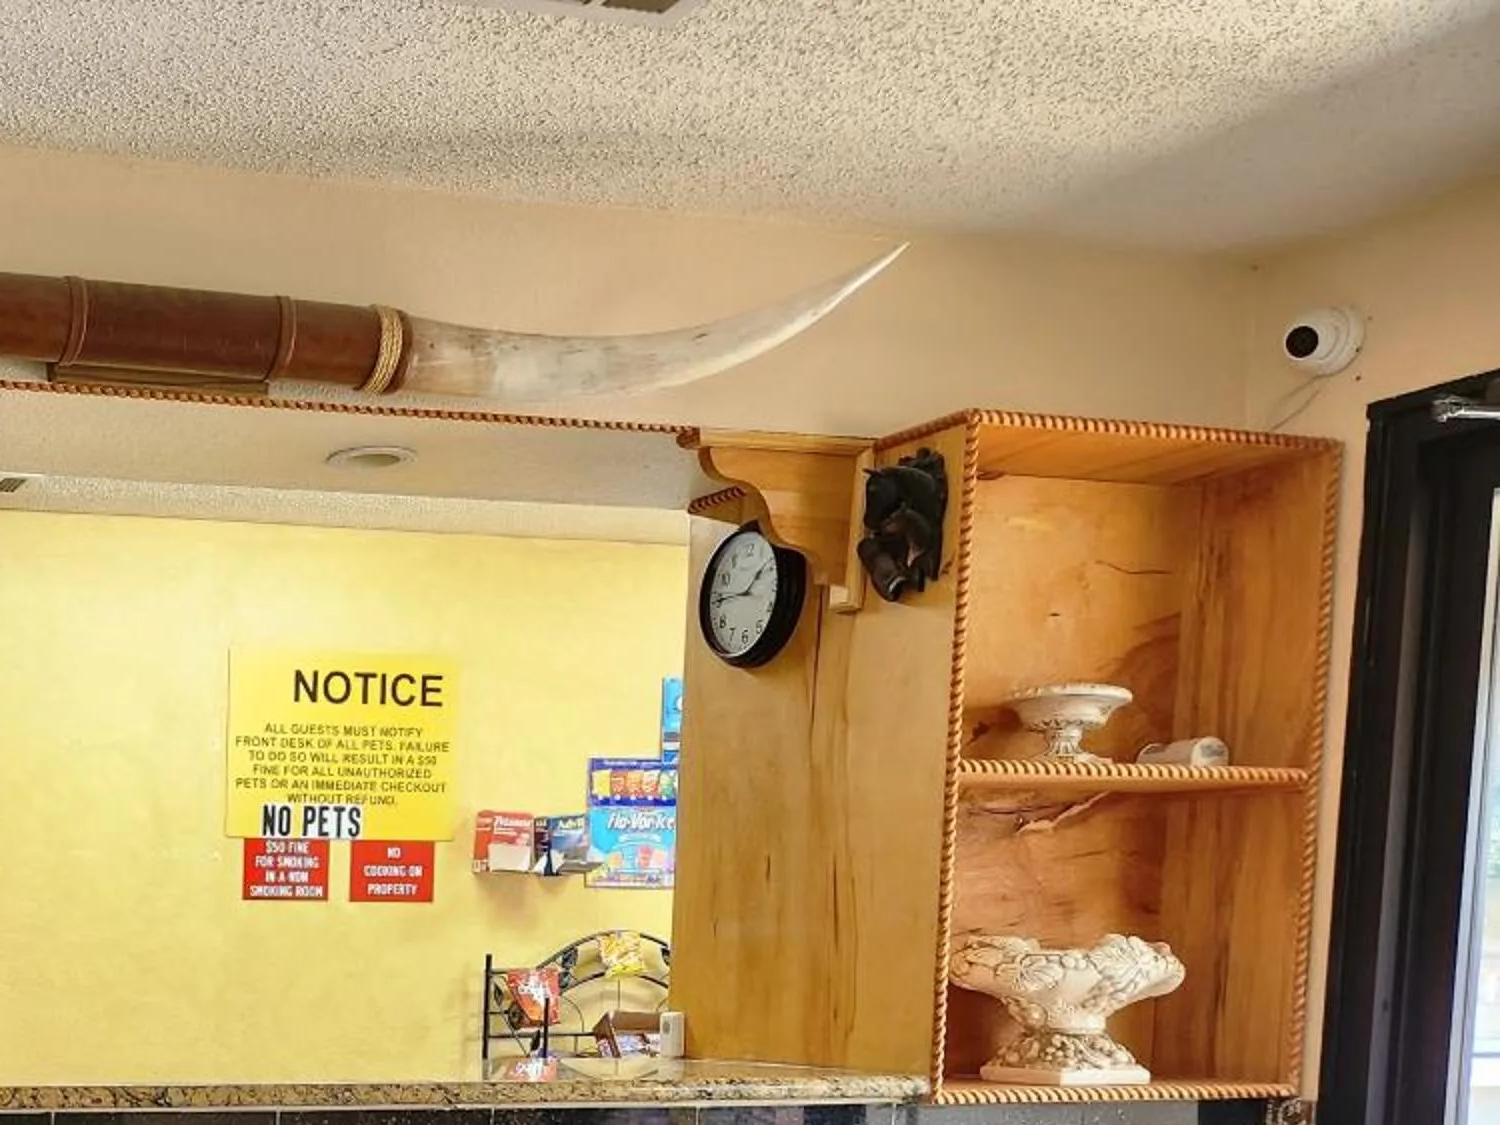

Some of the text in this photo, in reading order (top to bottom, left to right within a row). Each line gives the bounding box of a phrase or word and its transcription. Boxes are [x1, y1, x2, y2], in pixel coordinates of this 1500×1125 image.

[729, 628, 736, 641] 7
[741, 629, 749, 644] 6
[293, 669, 443, 707] NOTICE
[265, 722, 423, 738] ALL GUESTS MUST NOTIFY
[235, 735, 277, 747] FRONT
[280, 737, 313, 748] DESK
[317, 739, 332, 749] OF
[336, 739, 359, 750] ALL
[399, 741, 450, 752] FAILURE
[249, 750, 265, 761] TO
[268, 751, 286, 762] DO
[289, 751, 307, 763] SO
[309, 752, 339, 763] WILL
[343, 753, 389, 765] RESULT
[392, 754, 403, 765] IN
[406, 755, 414, 765] A
[253, 763, 432, 779] FINE FOR ALL UNAUTHORIZED
[235, 777, 446, 793] PETS OR AN IMMEDIATE CHECKOUT
[287, 793, 343, 804] WITHOUT
[262, 804, 361, 838] NO PETS
[288, 841, 309, 854] FINE
[387, 847, 401, 859] NO
[255, 855, 321, 869] FOR SMOKING
[265, 870, 275, 882] IN
[278, 870, 286, 882] A
[363, 865, 423, 878] COOKING ON
[249, 885, 323, 897] SMOKING ROOM
[367, 883, 419, 896] PROPERTY
